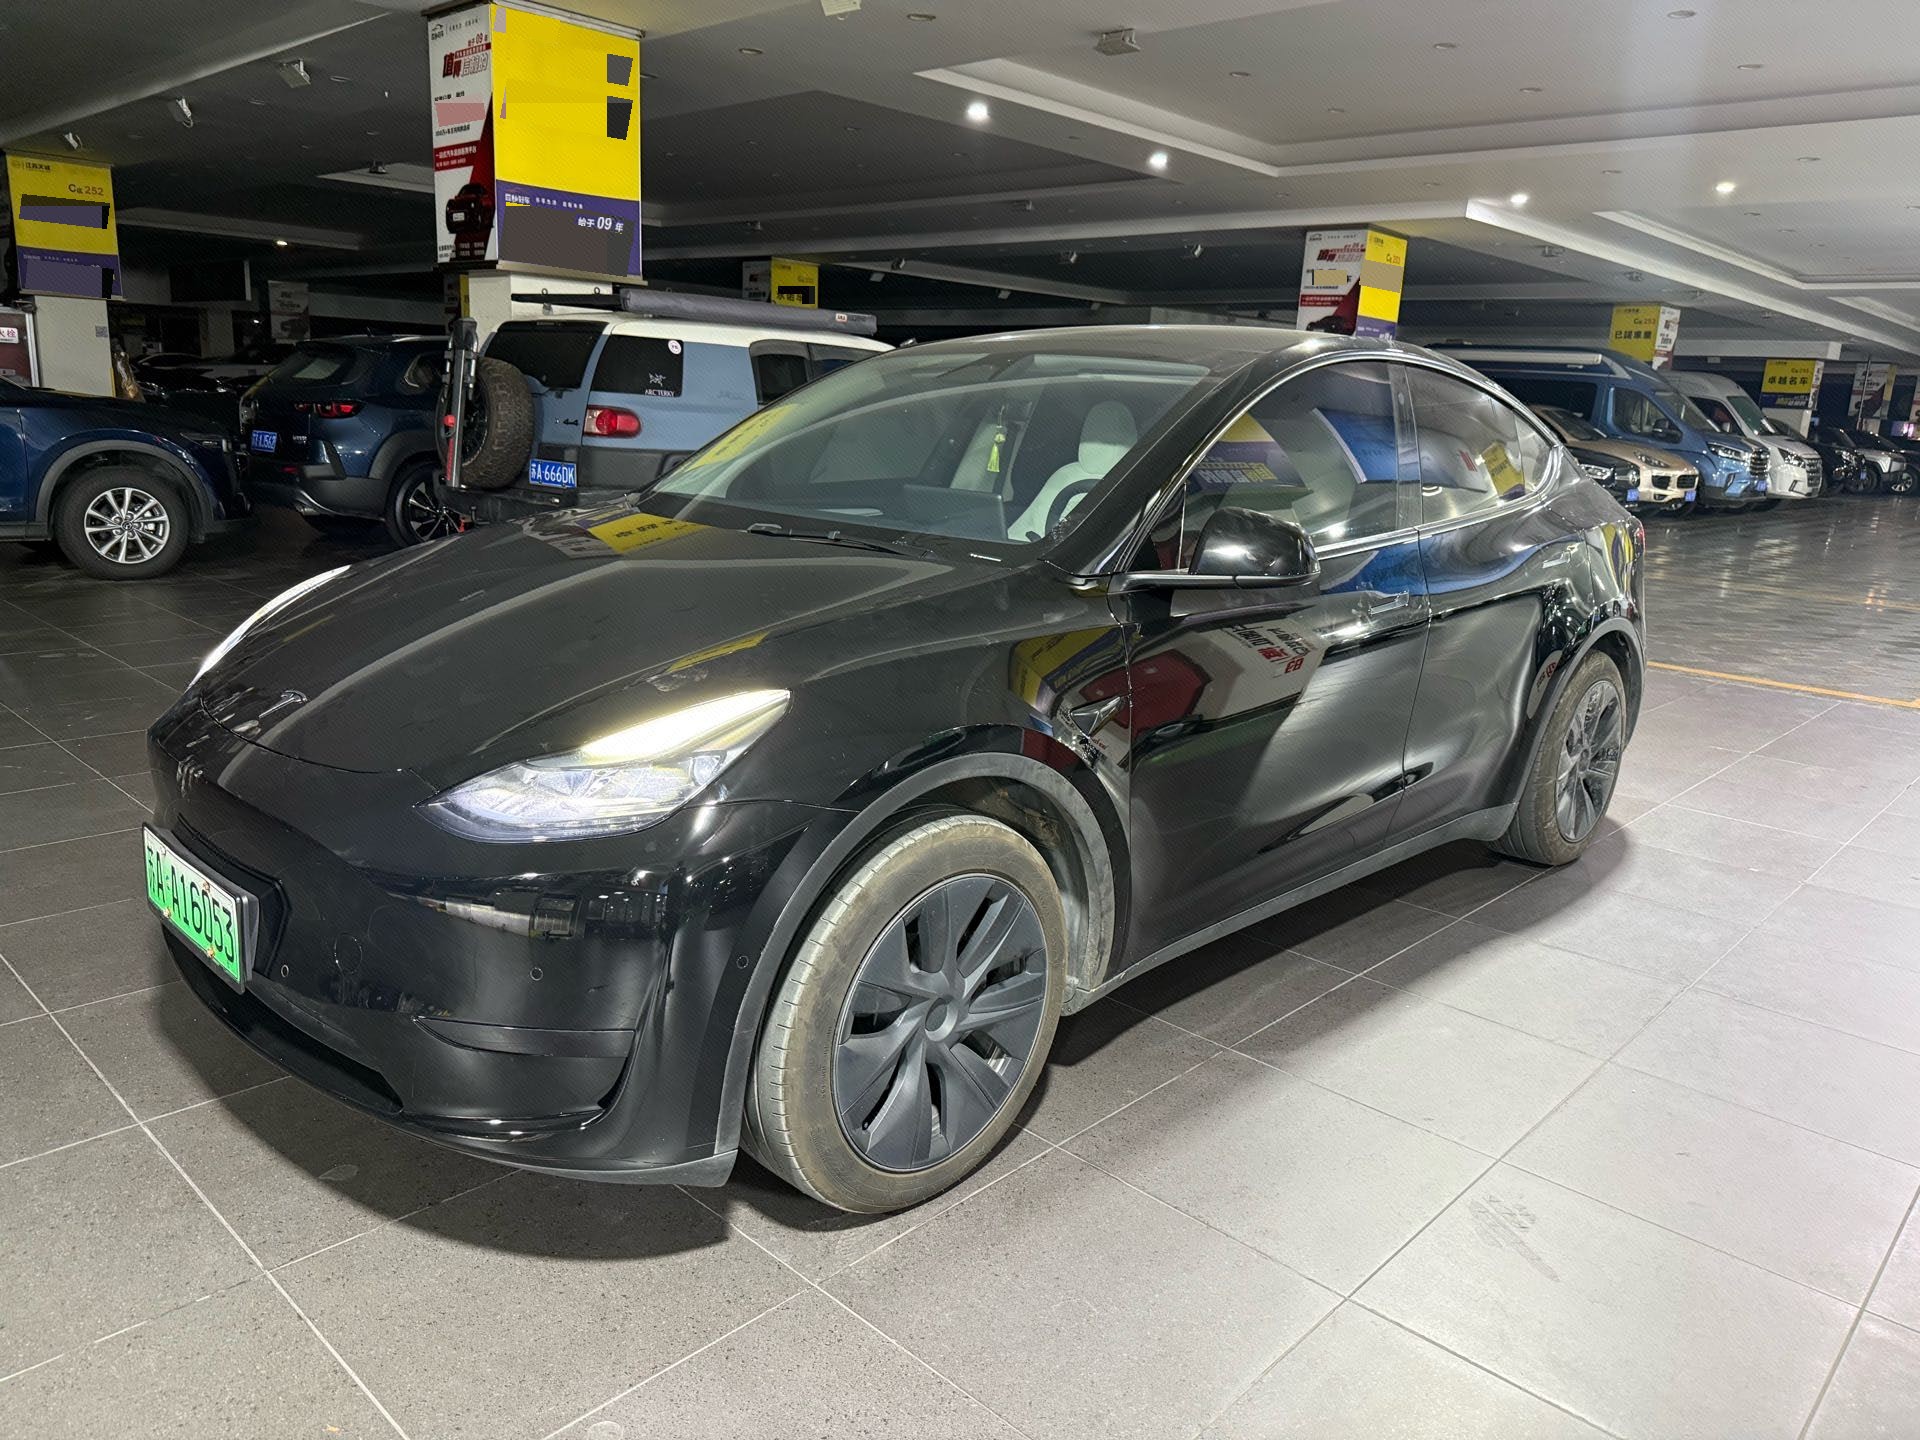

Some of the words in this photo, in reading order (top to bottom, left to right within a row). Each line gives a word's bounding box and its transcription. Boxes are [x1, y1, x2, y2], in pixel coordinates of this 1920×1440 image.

[84, 185, 104, 196] 252
[596, 216, 613, 231] 09
[614, 222, 625, 233] 年
[1768, 375, 1809, 386] 卓越名车
